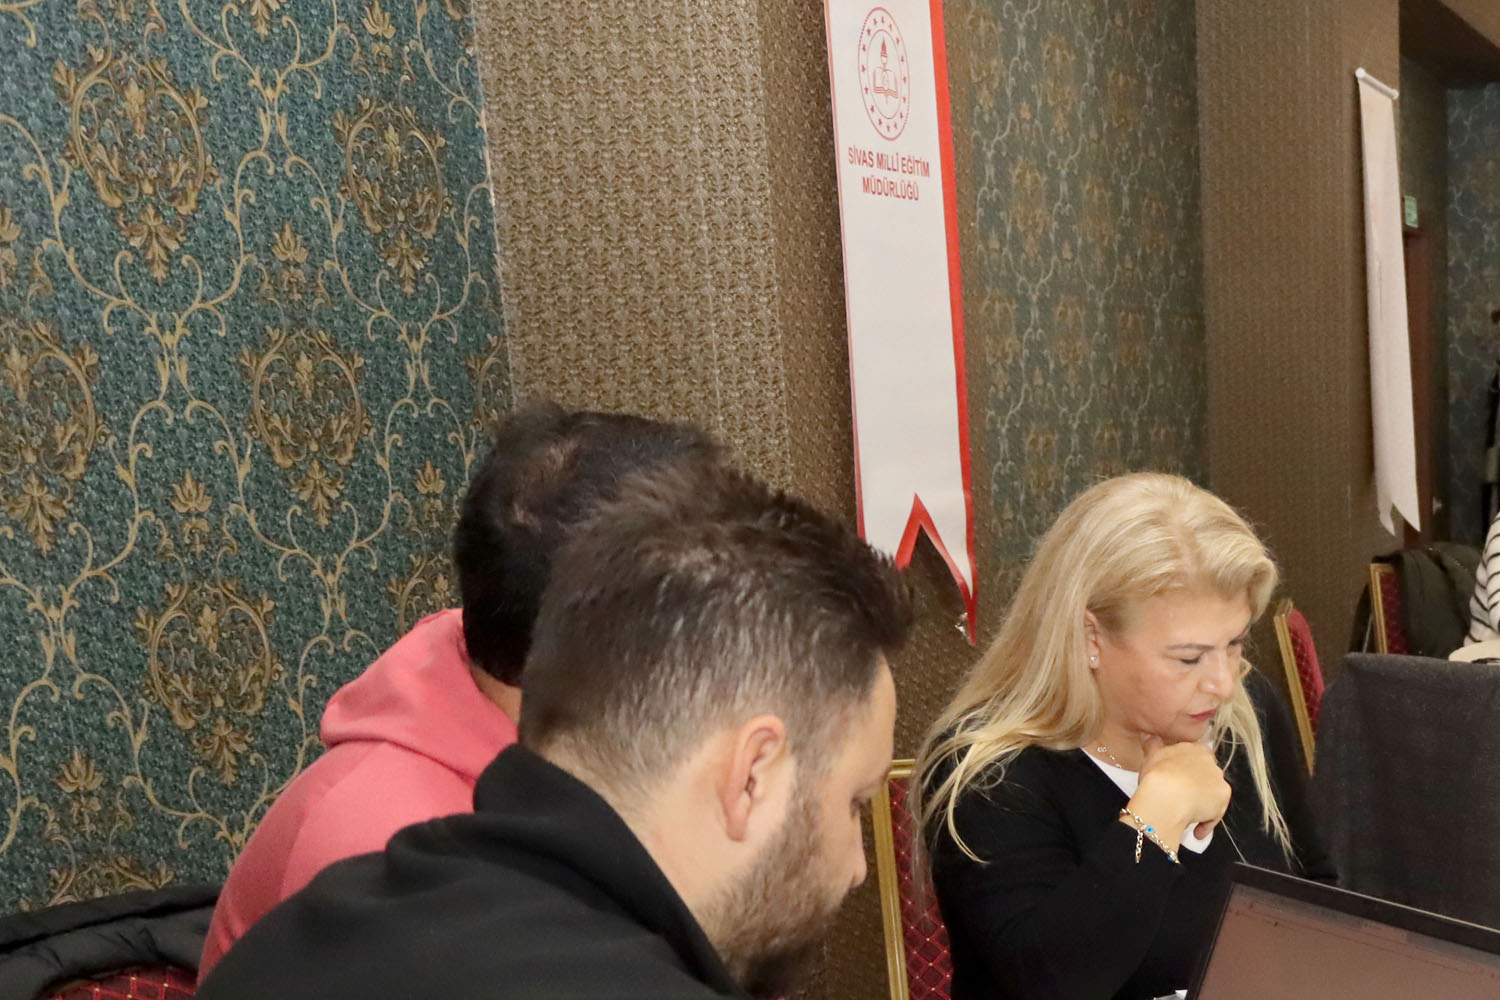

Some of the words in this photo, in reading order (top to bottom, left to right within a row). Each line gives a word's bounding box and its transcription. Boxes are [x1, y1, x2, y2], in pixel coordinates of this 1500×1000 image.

[848, 144, 874, 168] SİVAS
[901, 154, 930, 178] EĞİTİM
[862, 174, 919, 201] MÜDÜRLÜĞÜ
